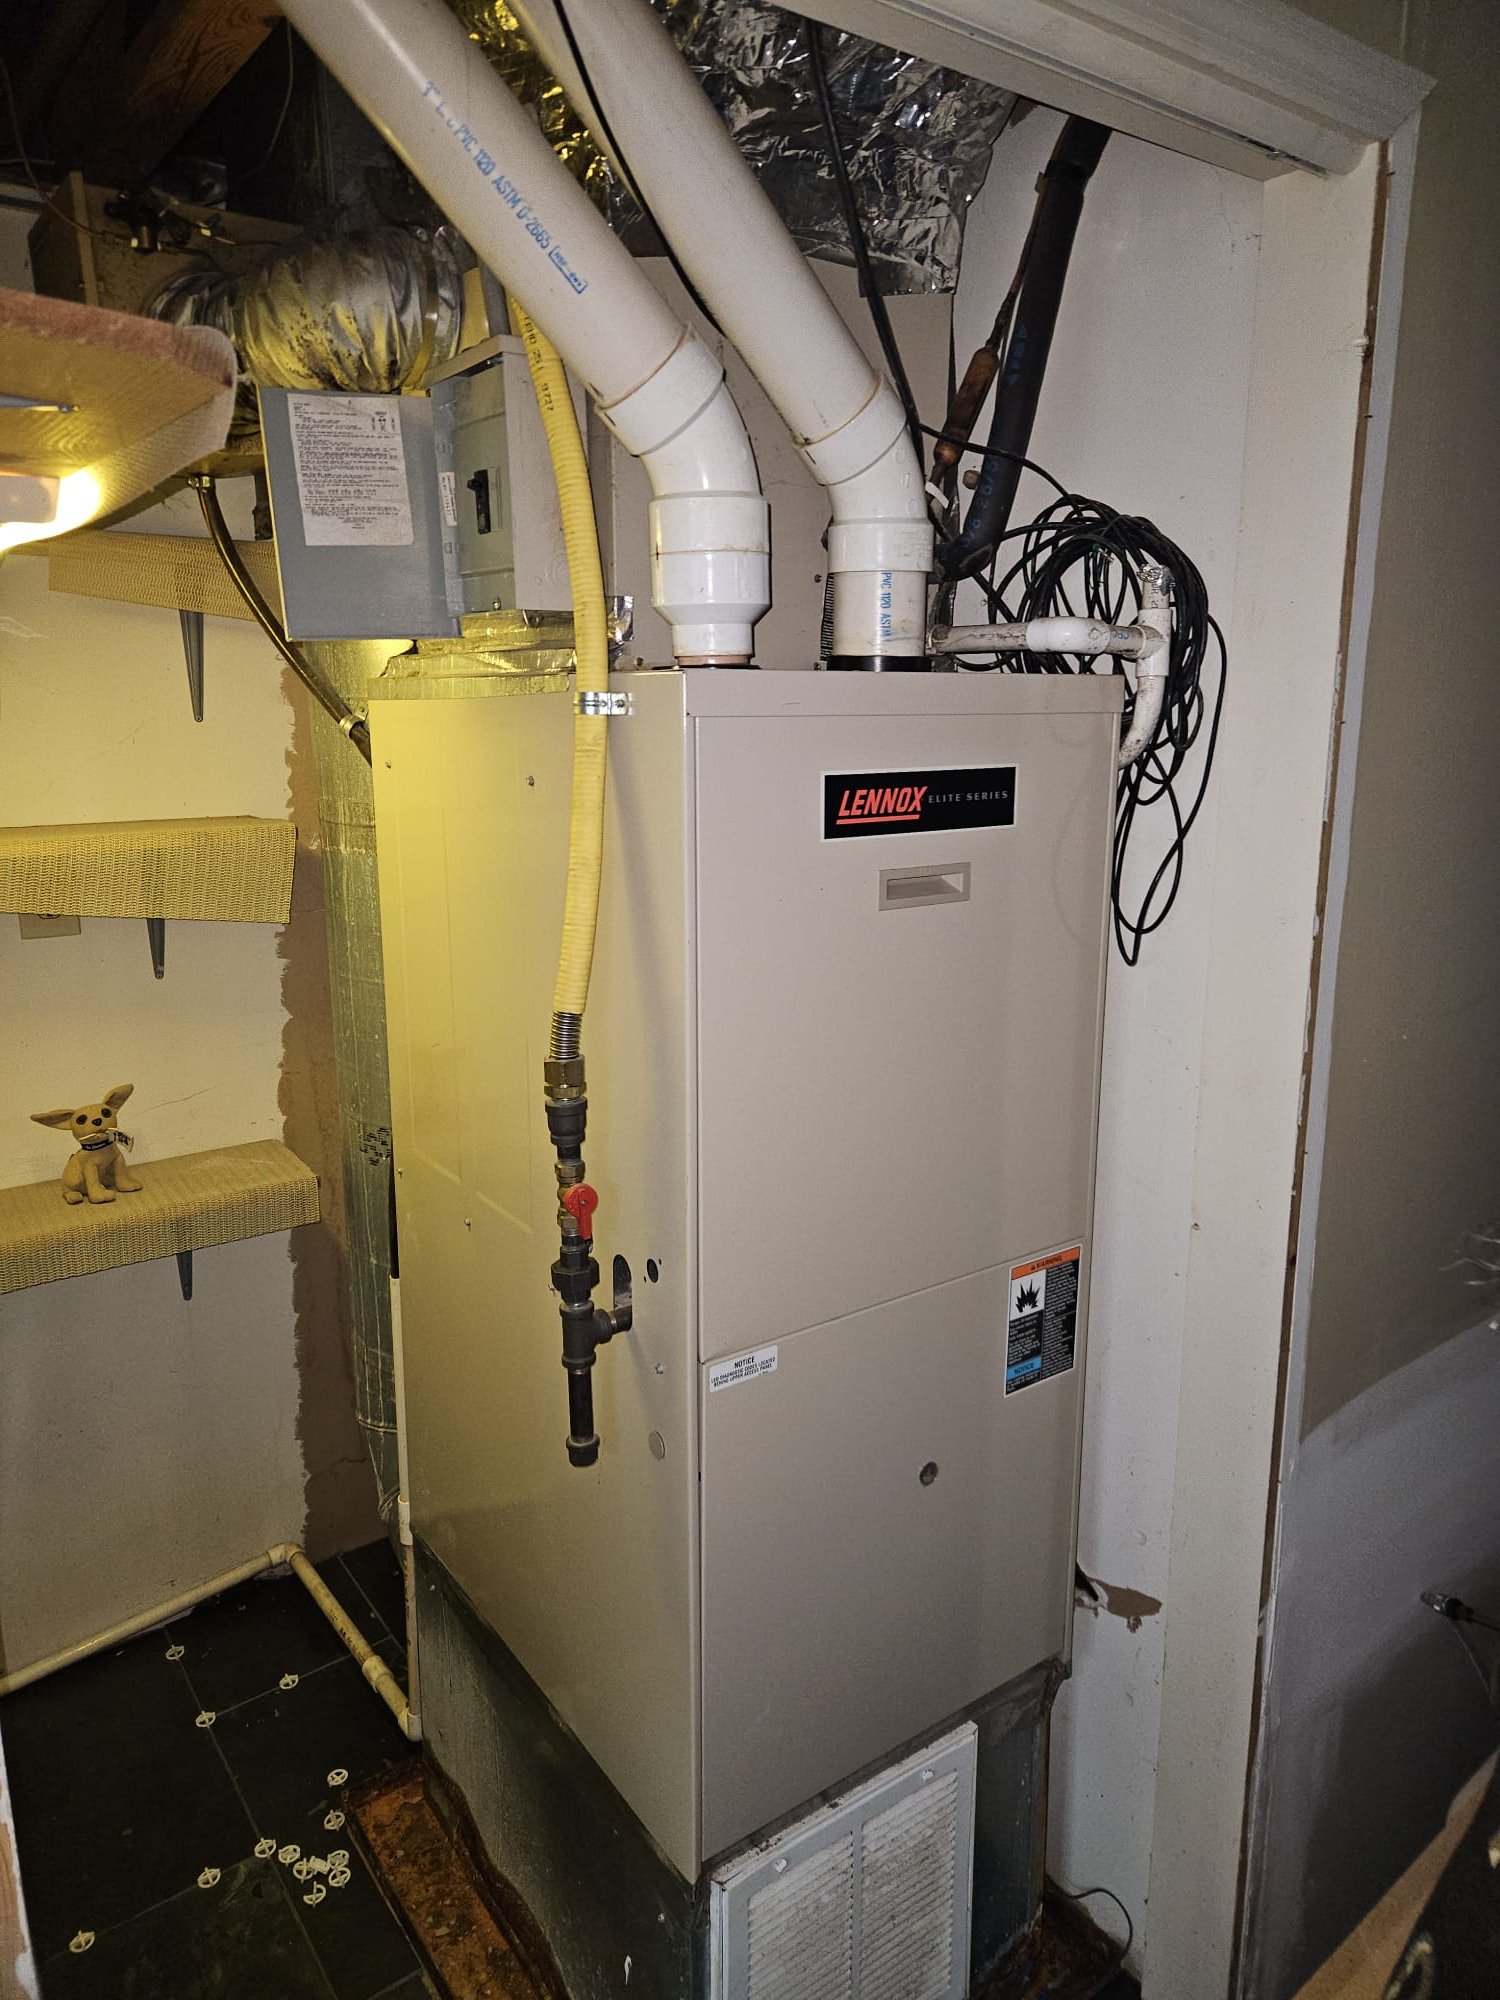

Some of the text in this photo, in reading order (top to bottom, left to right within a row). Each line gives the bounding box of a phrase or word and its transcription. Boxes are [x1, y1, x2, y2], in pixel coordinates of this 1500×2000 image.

[473, 149, 496, 175] 1120
[491, 174, 522, 208] ASTM
[880, 571, 892, 636] PVC 1120 ASTM
[838, 786, 1008, 817] LENNOX ELITE SERIES
[734, 1356, 755, 1369] NOTICE
